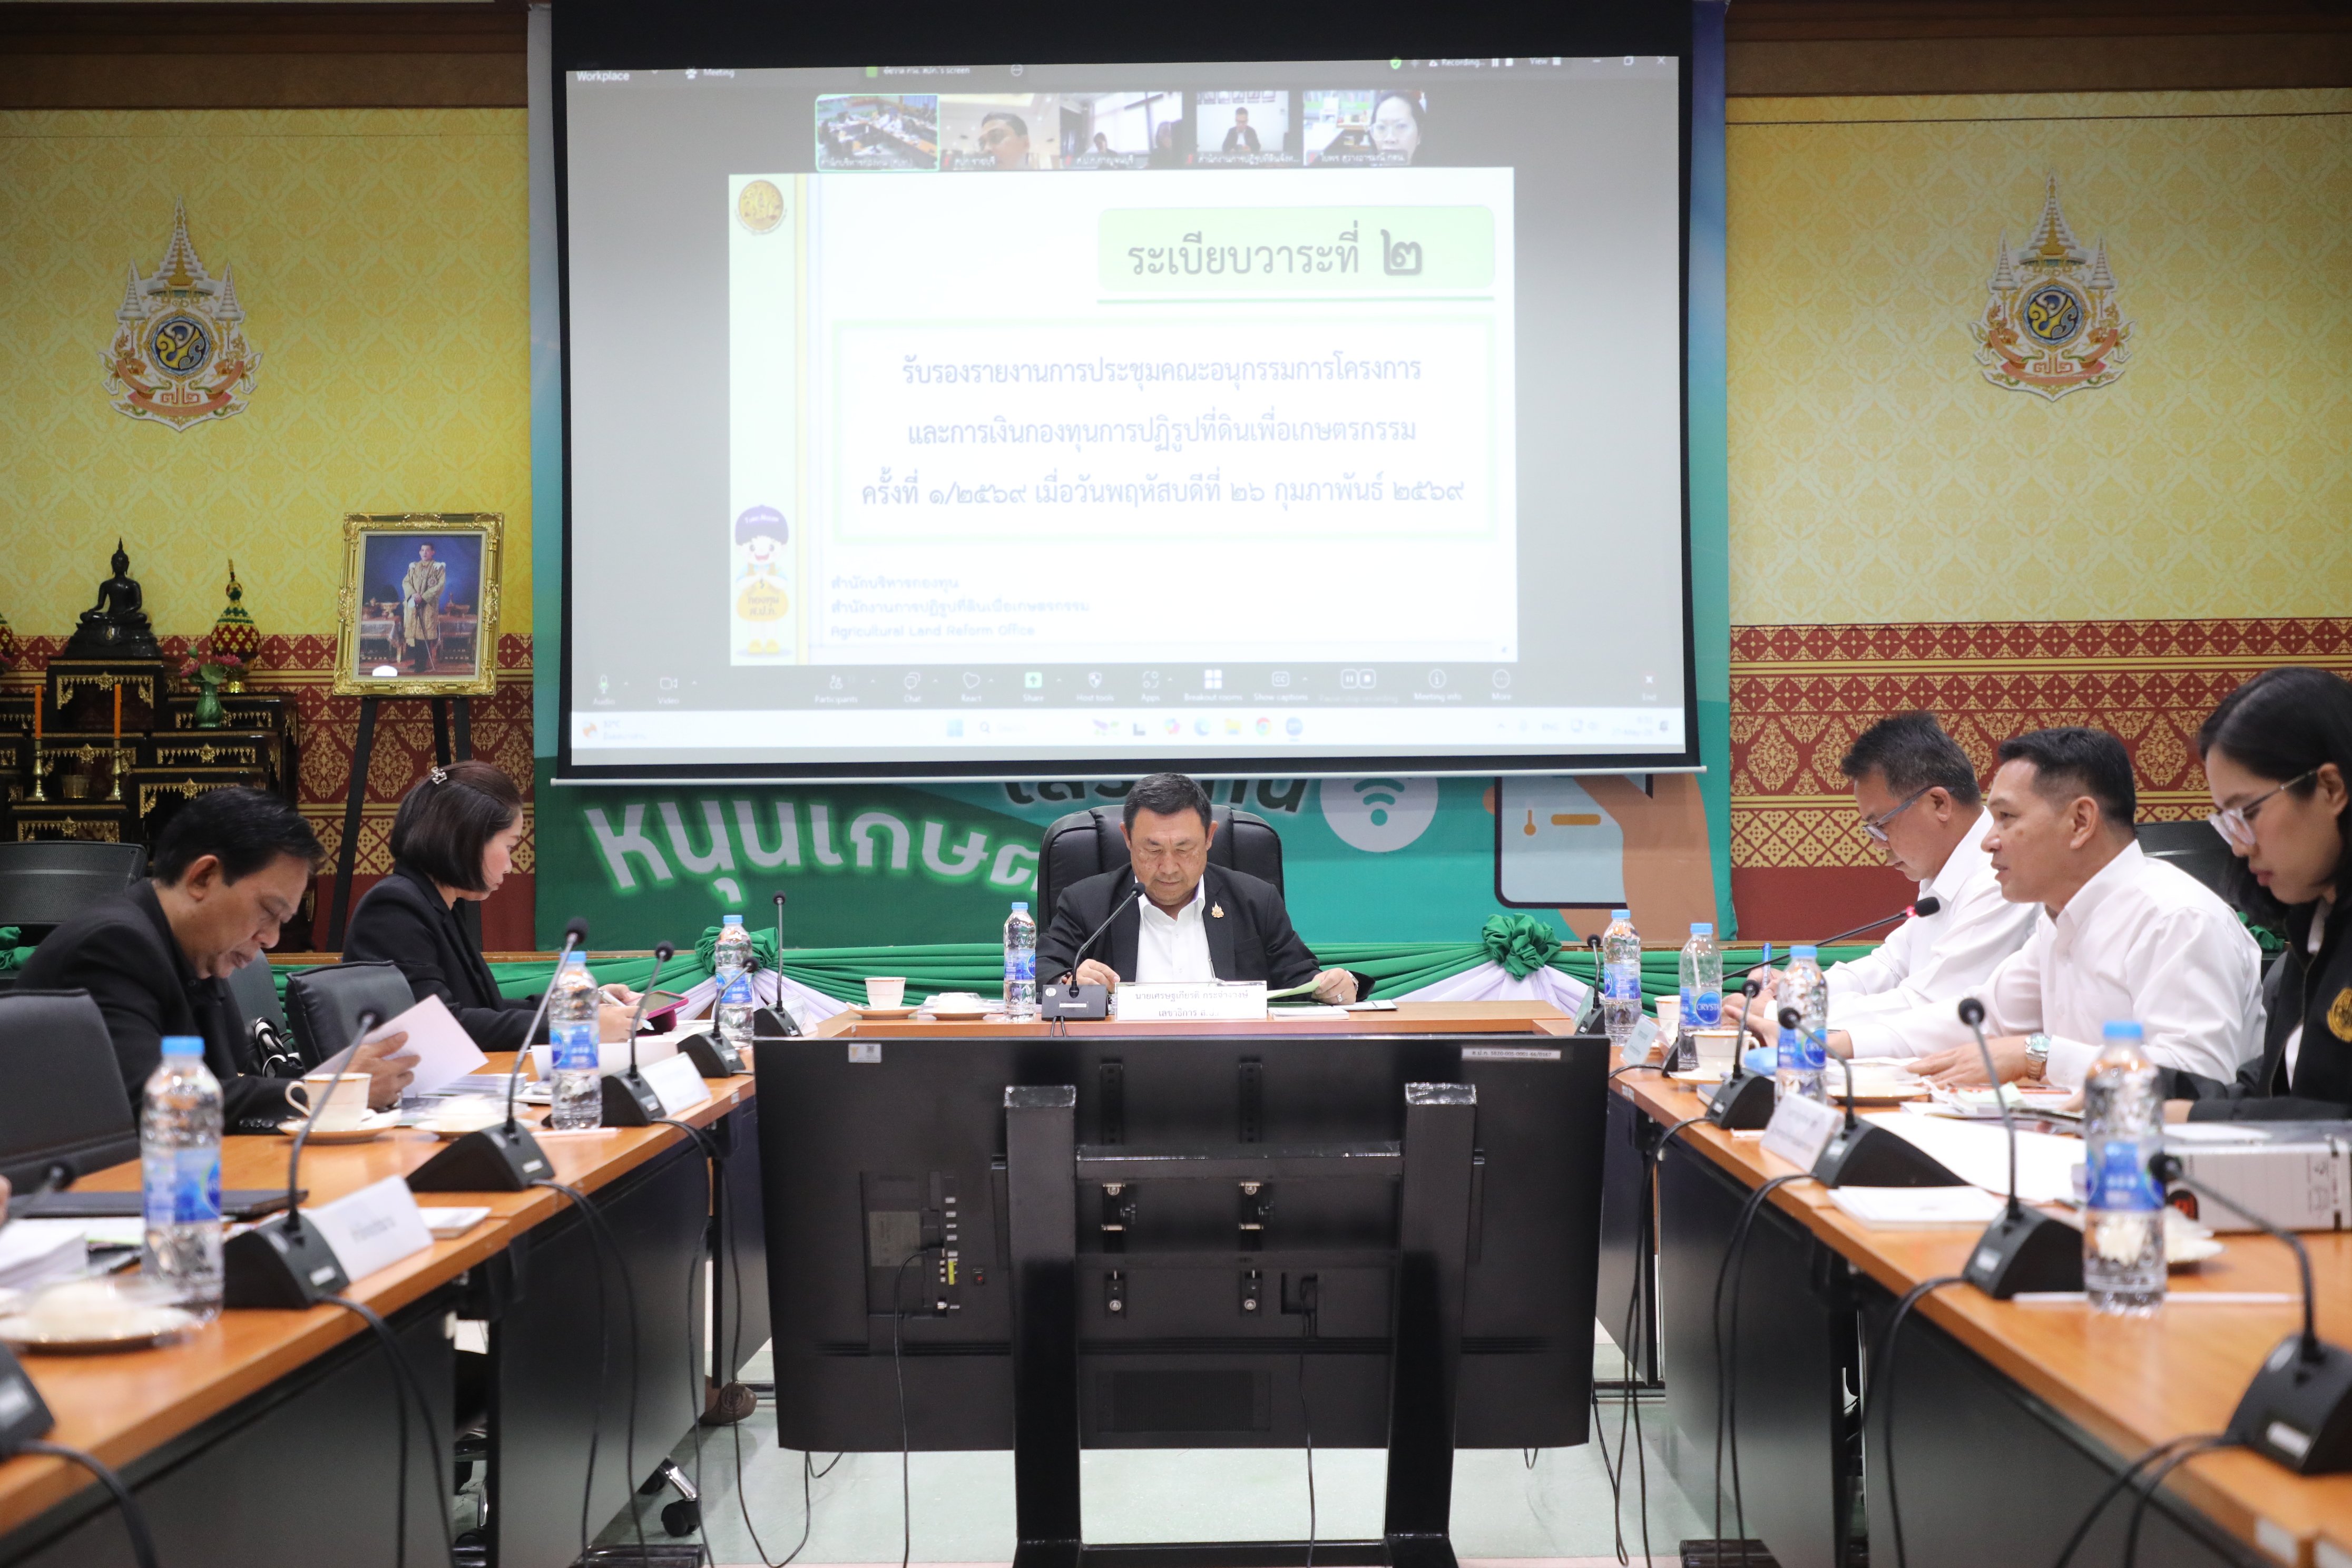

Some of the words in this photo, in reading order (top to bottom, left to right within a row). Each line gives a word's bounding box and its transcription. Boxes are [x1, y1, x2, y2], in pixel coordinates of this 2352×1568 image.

[576, 71, 630, 82] Workplace
[703, 69, 735, 79] Meeting
[1128, 220, 1359, 276] ระเบียบวาระที่
[1380, 229, 1423, 277] ๒
[902, 350, 1422, 391] รับรองรายงานการประชุมคณะอนุกรรมการโครงการ
[908, 405, 1416, 453] และการเงินกองทุนการปฏิรูปที่ดินเพื่อเกษตรกรรม
[862, 466, 918, 505] ครั้งที่
[929, 481, 1027, 505] ๑/๒๕๖๙
[1035, 466, 1221, 507] เมื่อวันพฤหัสบดีที่
[1230, 482, 1265, 502] ๒๖
[1275, 469, 1384, 511] กุมภาพันธ์
[1393, 480, 1465, 501] ๒๕๖๙
[831, 625, 904, 641] Agricultural
[909, 625, 941, 637] Land
[947, 624, 993, 636] Reform
[998, 623, 1034, 635] Office
[658, 697, 680, 705] Video
[815, 694, 858, 705] Participants
[904, 694, 922, 703] Chat
[961, 694, 982, 702] React
[1022, 693, 1044, 702] Share
[1076, 693, 1093, 702] Host
[1095, 693, 1114, 702] tools
[1141, 693, 1160, 704] Apps
[1184, 693, 1217, 701] Breakout
[1253, 693, 1275, 701] Show
[1276, 693, 1309, 703] captions
[1414, 692, 1445, 703] Meeting
[1447, 692, 1462, 701] info
[1492, 692, 1512, 701] More
[1159, 1007, 1197, 1017] เลขาธิการ
